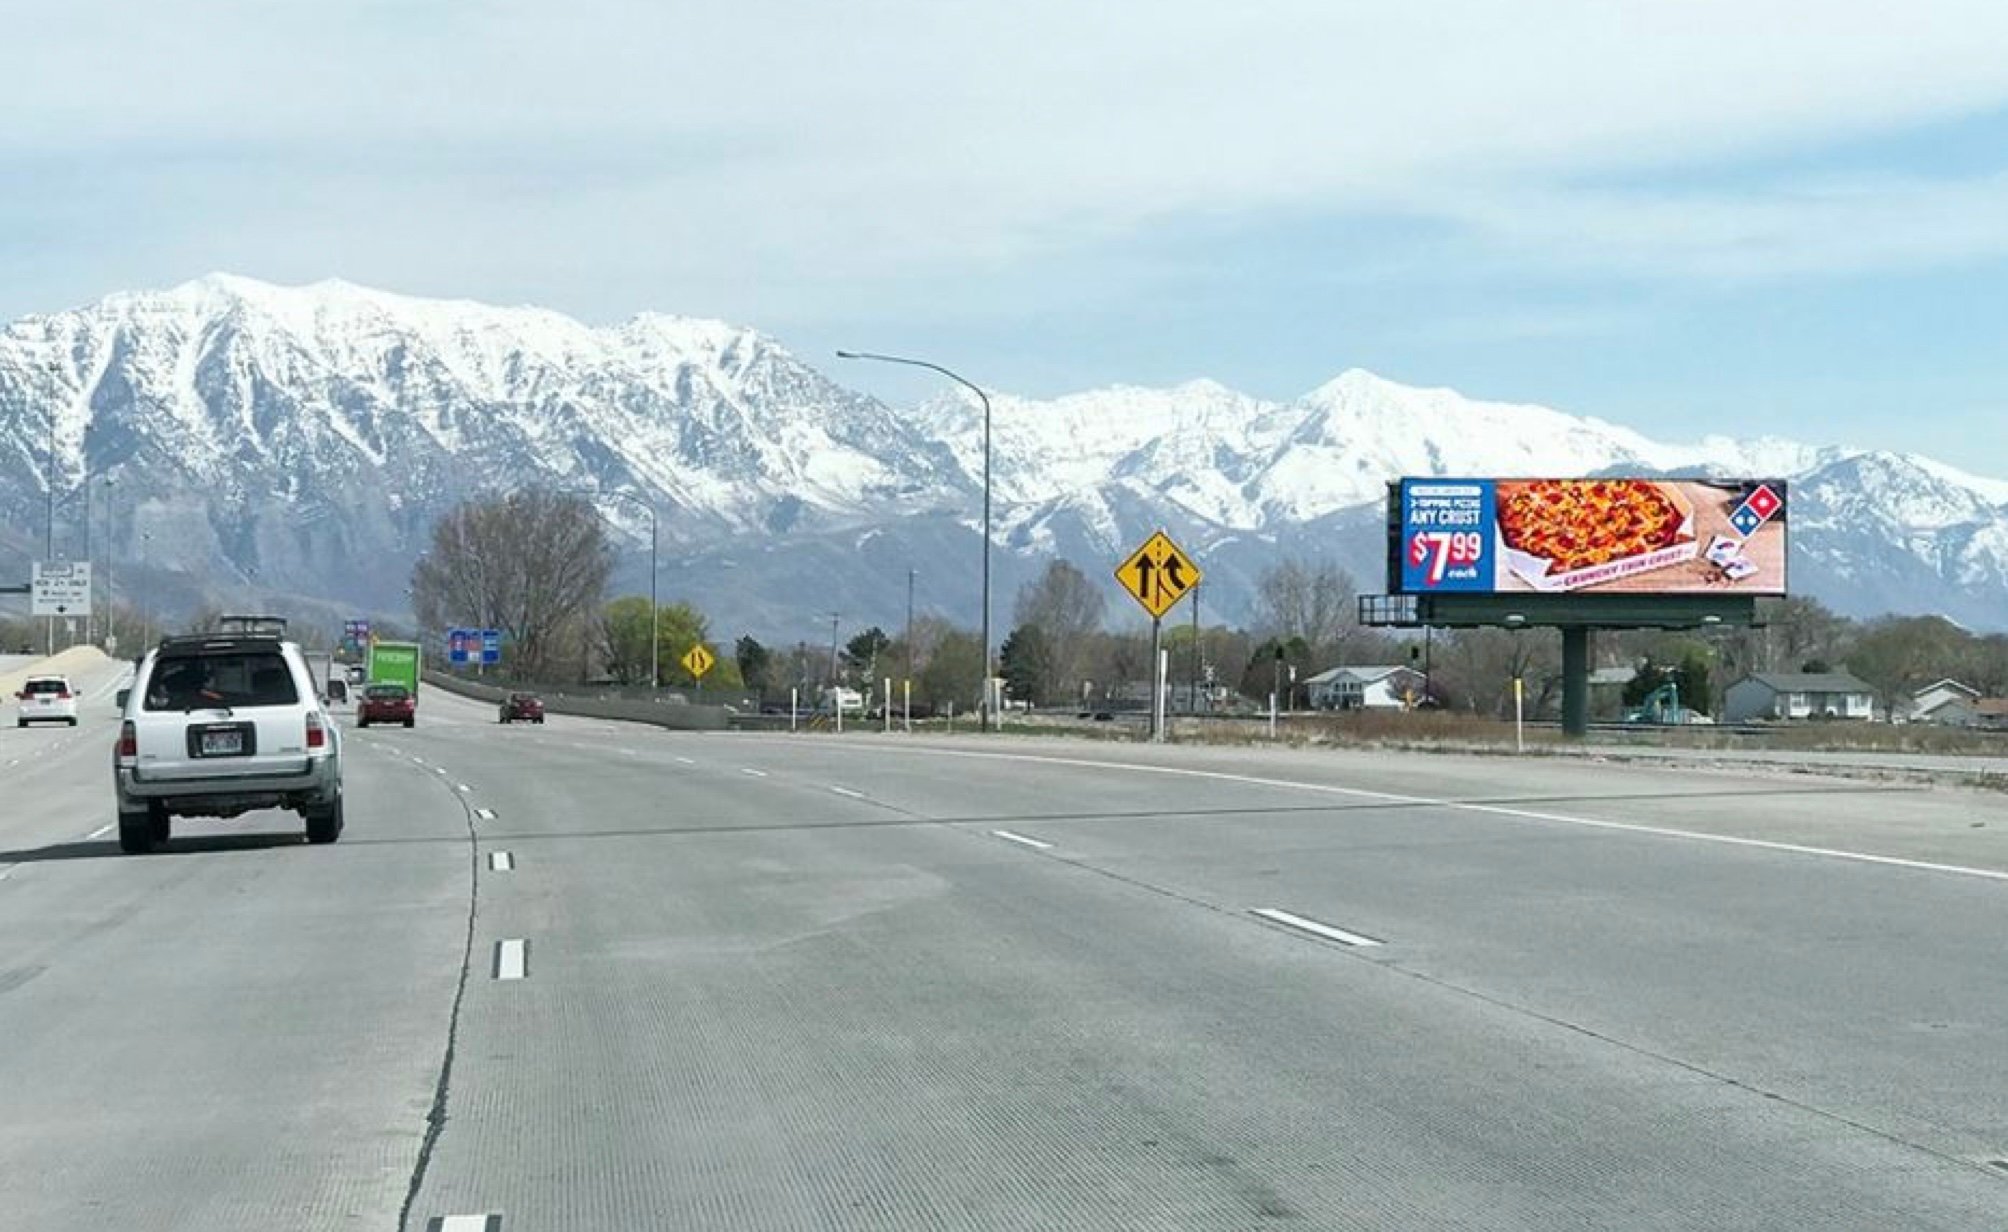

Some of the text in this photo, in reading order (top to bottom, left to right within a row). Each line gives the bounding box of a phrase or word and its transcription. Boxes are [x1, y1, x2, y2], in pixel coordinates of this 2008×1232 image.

[1410, 510, 1481, 524] ANY CRUST
[1447, 566, 1478, 578] each
[1564, 564, 1619, 586] CRUNCHY
[1649, 548, 1684, 566] CRUST
